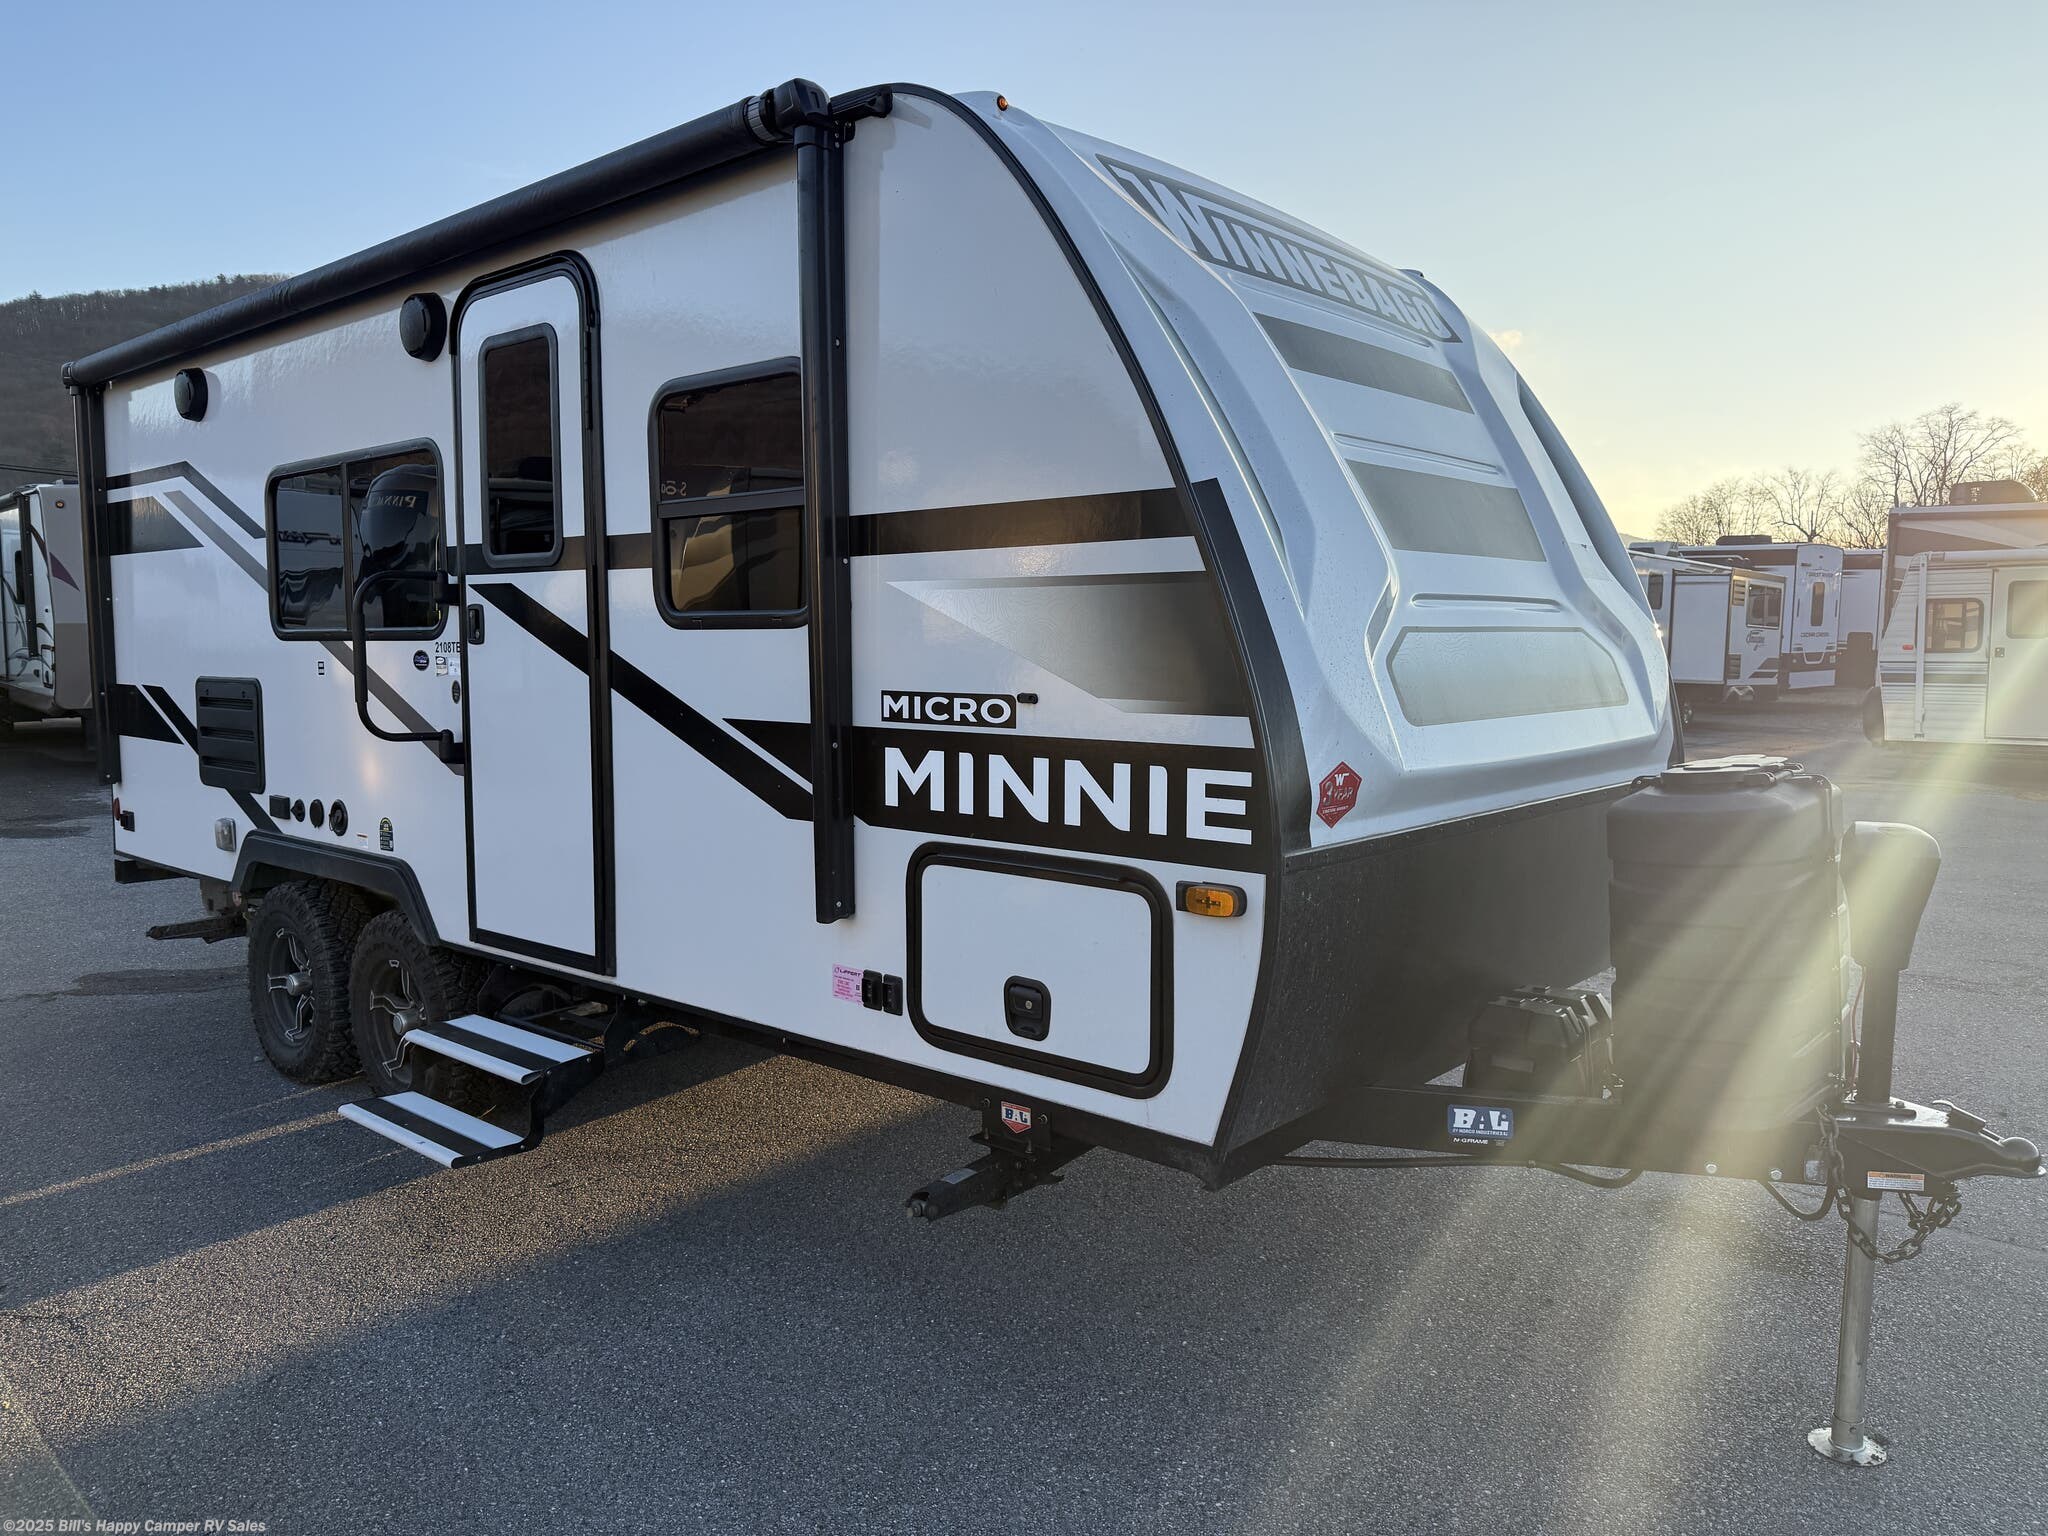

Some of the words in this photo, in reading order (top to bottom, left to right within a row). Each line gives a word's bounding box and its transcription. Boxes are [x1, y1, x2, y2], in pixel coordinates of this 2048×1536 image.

[1105, 162, 1452, 339] WINNEBAGO
[882, 694, 1012, 724] MICRO
[884, 746, 1253, 845] MINNIE
